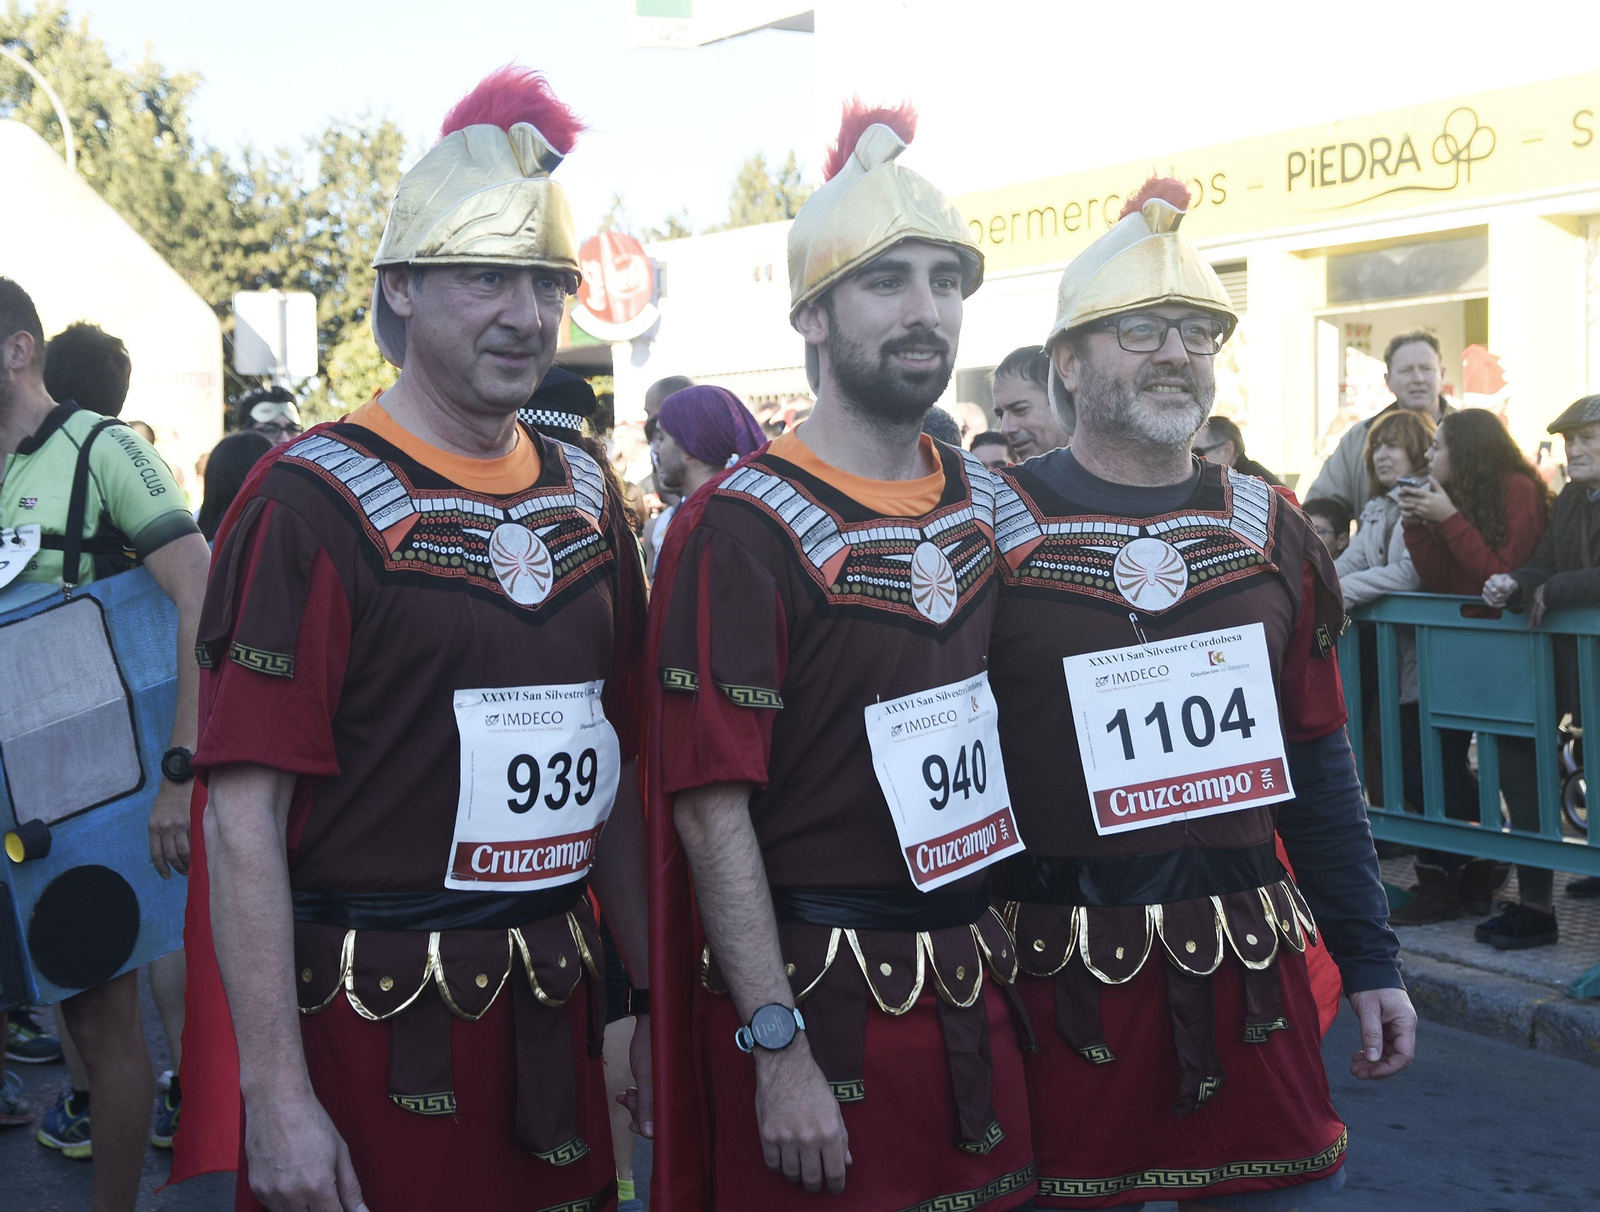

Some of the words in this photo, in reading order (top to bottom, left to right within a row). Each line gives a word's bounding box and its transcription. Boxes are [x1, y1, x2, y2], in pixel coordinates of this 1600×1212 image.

[140, 468, 167, 497] CLUB
[1088, 653, 1125, 668] XXXVI
[1127, 650, 1145, 661] San
[1146, 643, 1188, 659] Silvestre
[1190, 633, 1243, 650] Cordobesa
[1111, 664, 1170, 686] IMDECO
[480, 691, 520, 703] XXXVI
[522, 692, 542, 701] San
[544, 690, 584, 701] Silvestre
[885, 702, 916, 716] XXXVI
[916, 697, 934, 707] San
[935, 688, 966, 703] Silvestre
[502, 710, 564, 726] IMDECO
[904, 709, 958, 734] IMDECO
[1105, 686, 1256, 761] 1104
[506, 747, 598, 815] 939
[921, 739, 987, 811] 940
[1260, 767, 1274, 790] SIN
[1109, 771, 1252, 817] Cruzcampo
[999, 818, 1010, 840] SIN
[470, 838, 592, 874] Cruzcampo
[916, 823, 997, 874] Cruzcampo
